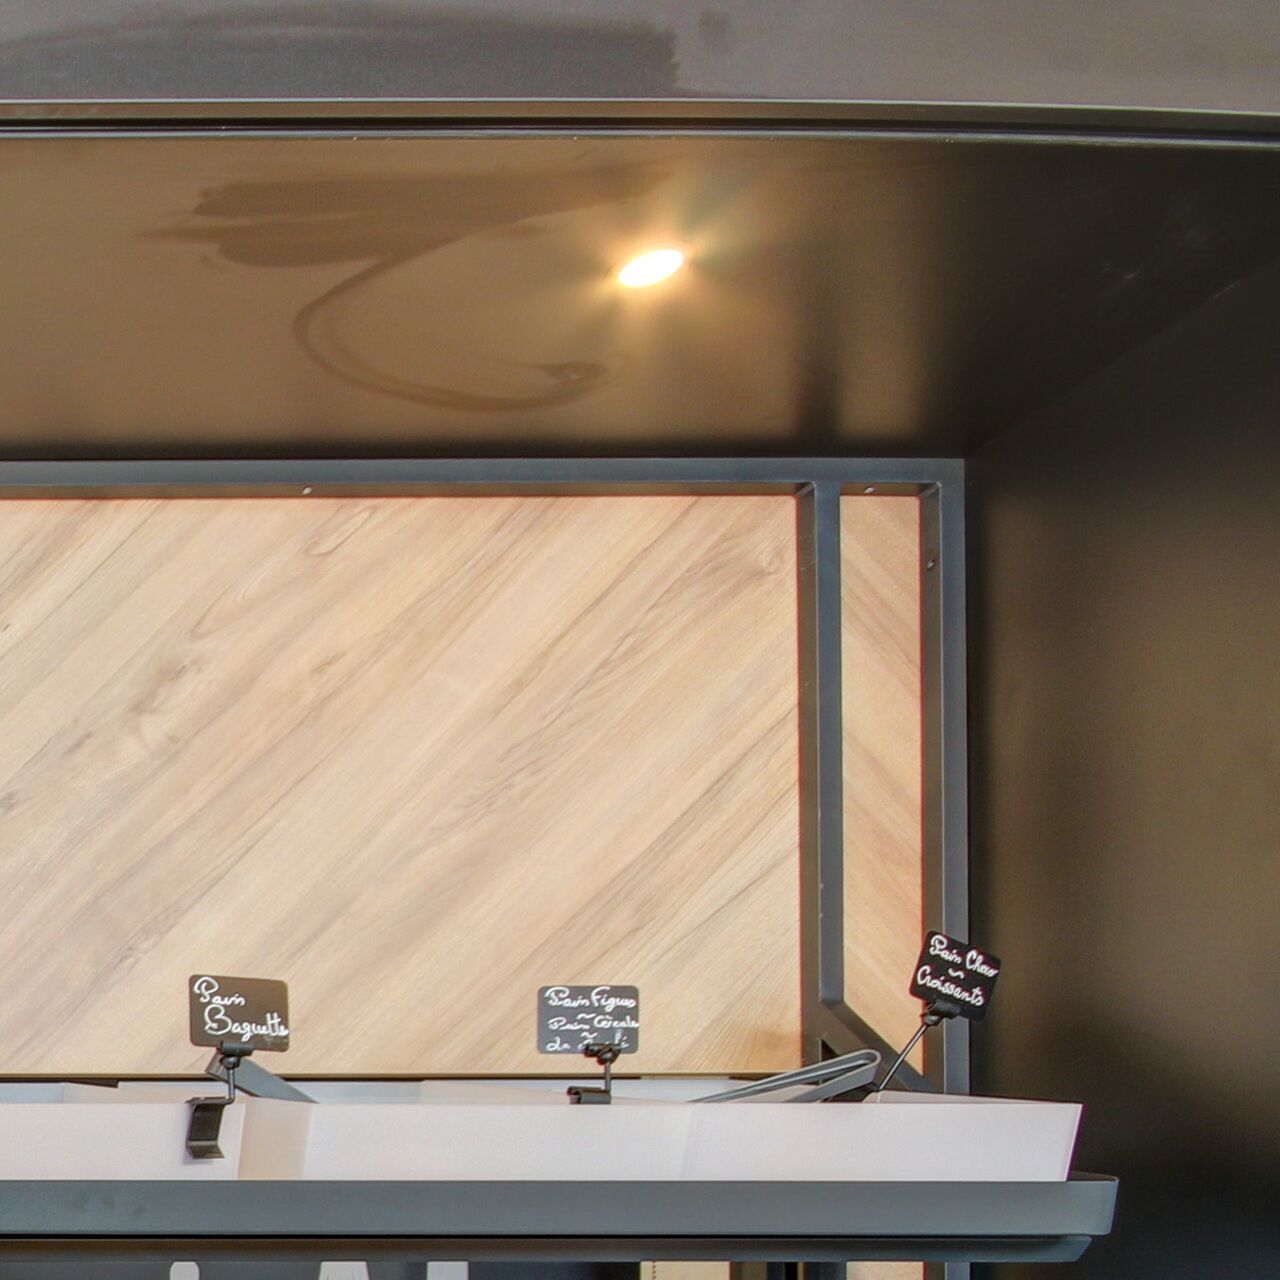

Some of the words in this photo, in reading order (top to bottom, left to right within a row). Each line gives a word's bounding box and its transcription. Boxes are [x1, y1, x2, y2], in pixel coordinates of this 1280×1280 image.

[929, 934, 962, 964] Pain
[193, 976, 245, 1006] Pain
[544, 987, 590, 1008] Pain
[917, 965, 984, 1006] Croissants
[204, 1004, 289, 1042] Baguette
